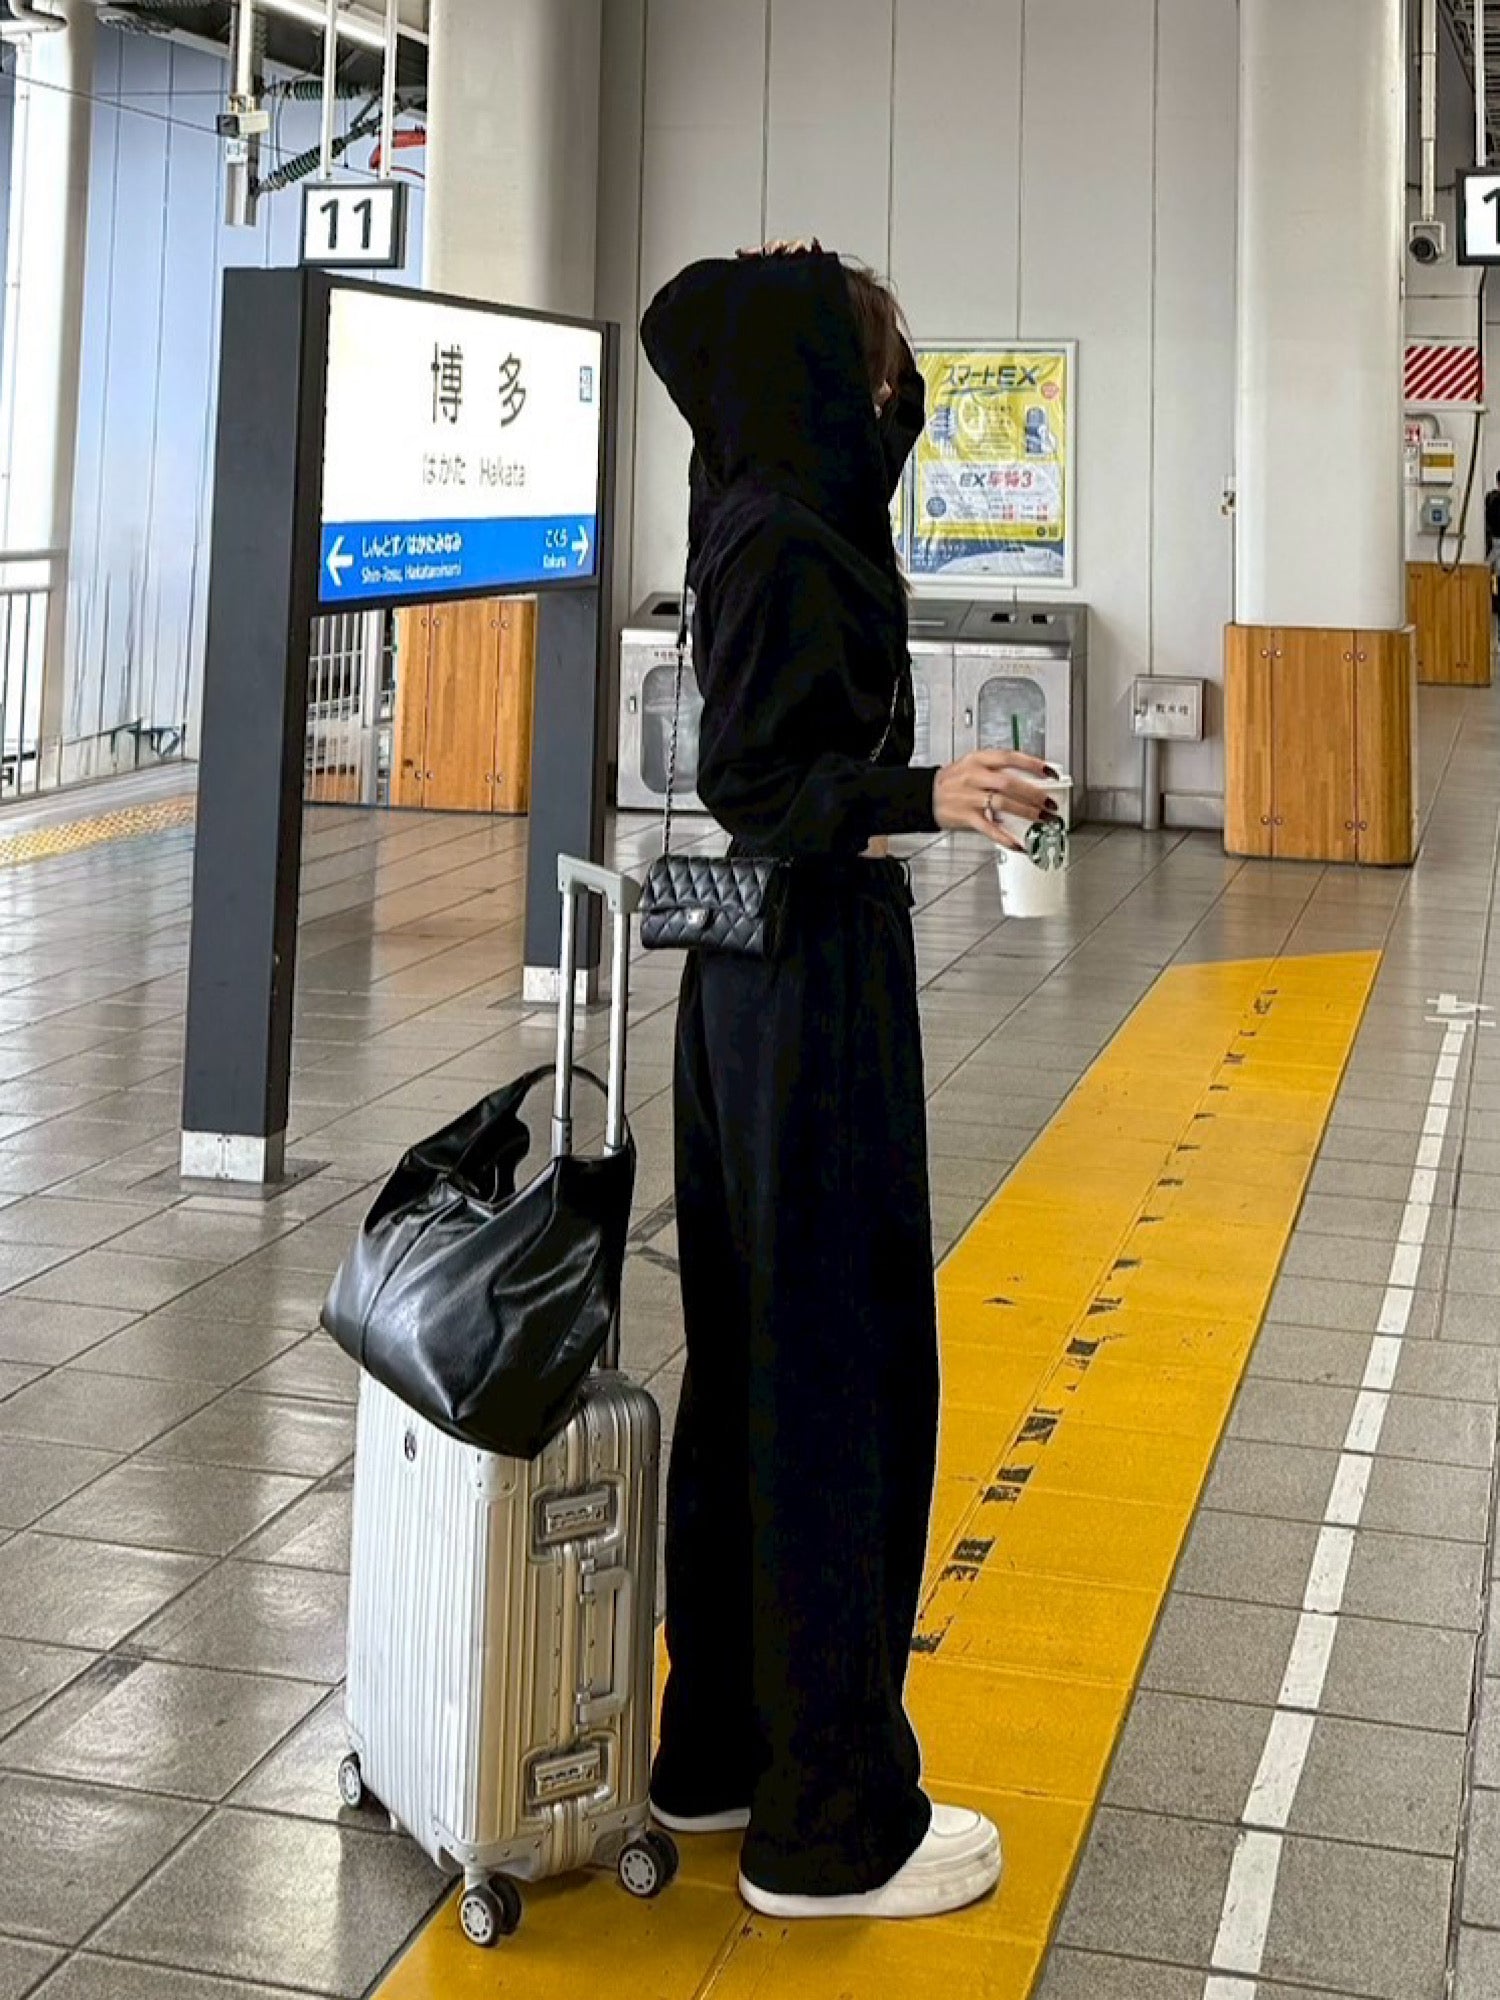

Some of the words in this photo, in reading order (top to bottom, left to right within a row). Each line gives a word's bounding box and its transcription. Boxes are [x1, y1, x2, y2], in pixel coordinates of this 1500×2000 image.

[320, 198, 373, 250] 11
[431, 341, 527, 428] 博多
[422, 452, 466, 486] はかた
[479, 455, 526, 487] Hakata
